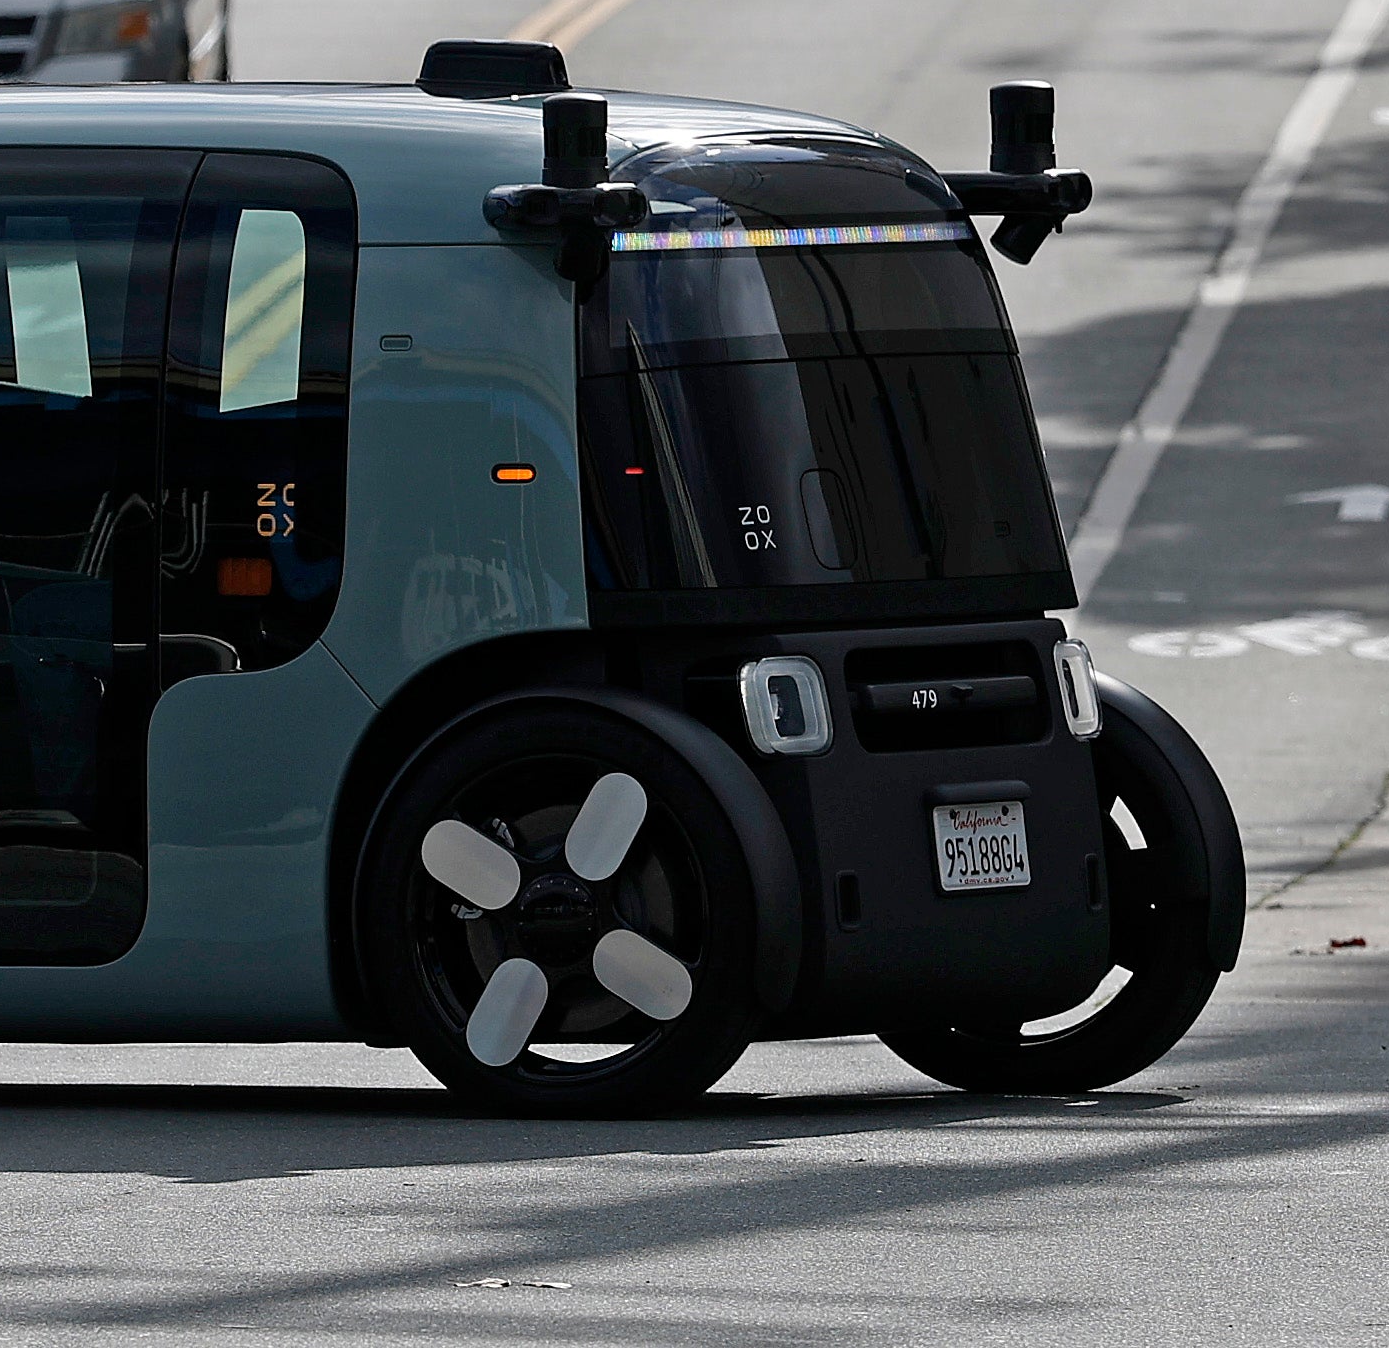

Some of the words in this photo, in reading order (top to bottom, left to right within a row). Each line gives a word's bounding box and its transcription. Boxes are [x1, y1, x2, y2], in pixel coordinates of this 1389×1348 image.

[912, 689, 938, 709] 479
[951, 810, 1009, 834] California
[945, 833, 1025, 878] 95188G4
